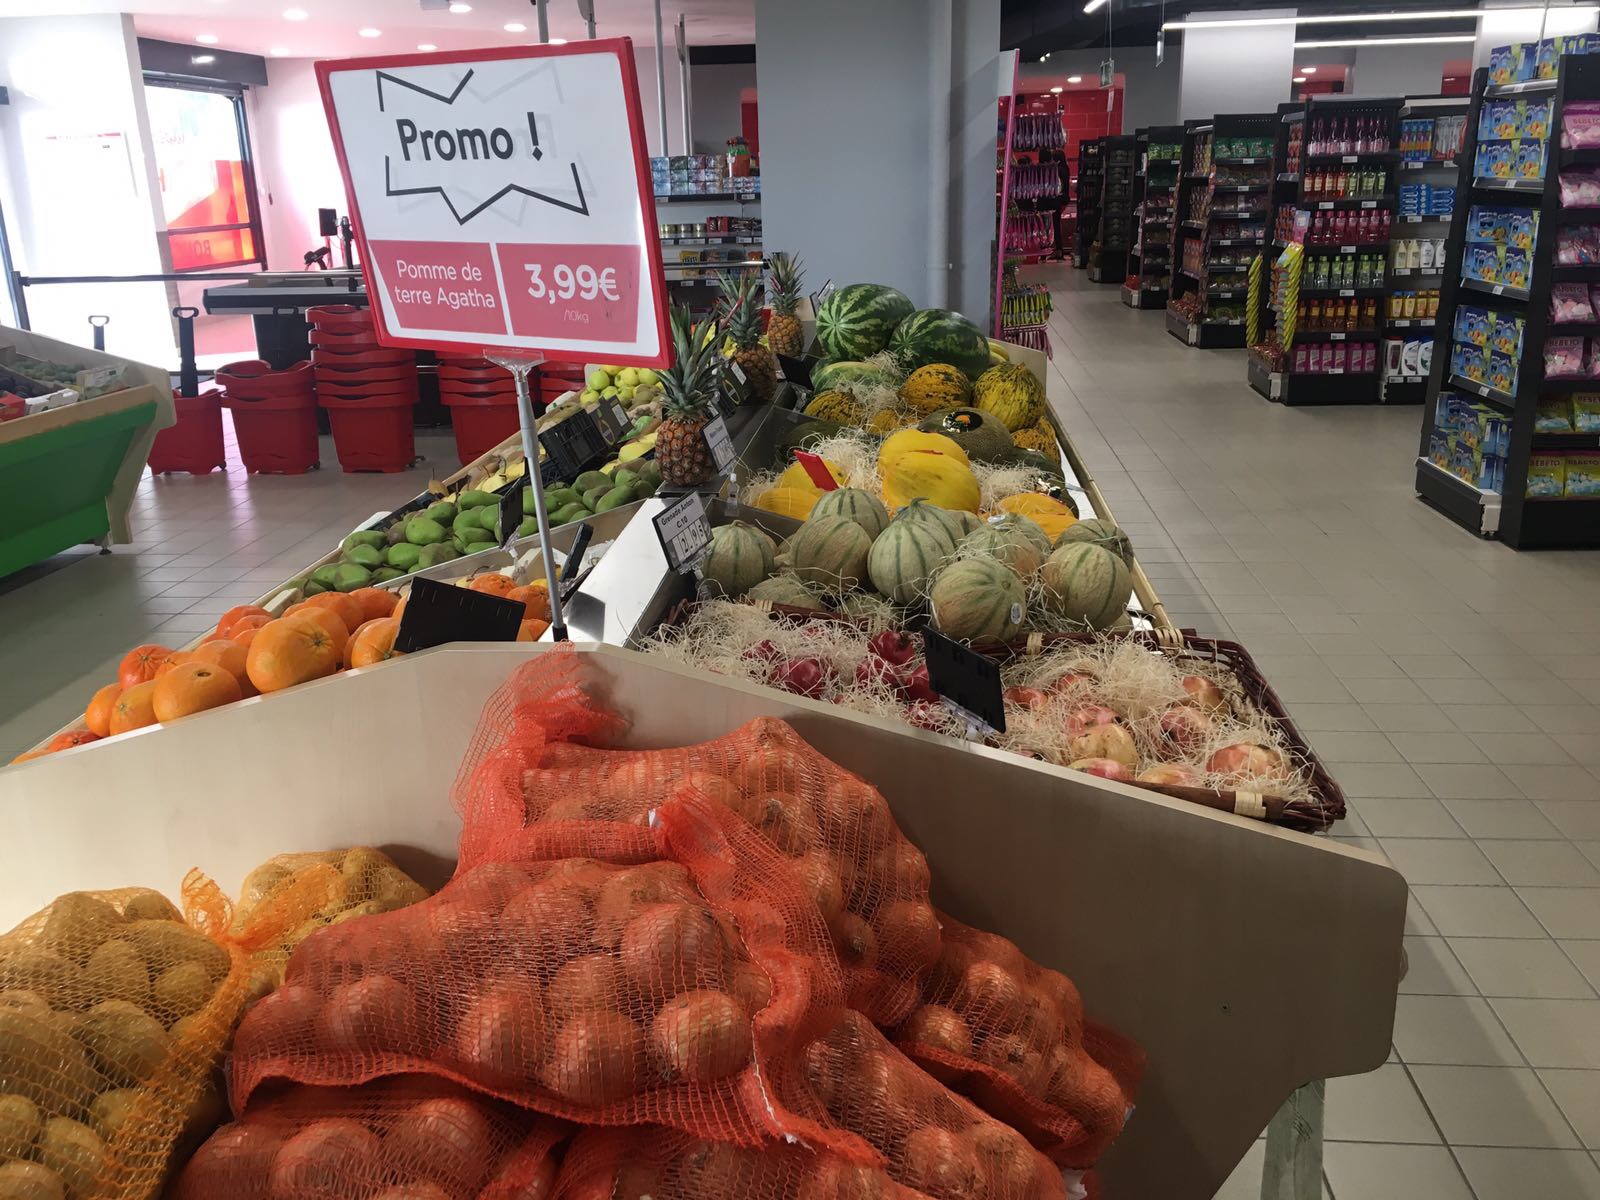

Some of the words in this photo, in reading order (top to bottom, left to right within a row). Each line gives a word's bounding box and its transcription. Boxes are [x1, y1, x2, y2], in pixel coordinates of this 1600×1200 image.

[396, 118, 514, 161] Promo
[527, 112, 543, 161] !
[396, 260, 457, 282] Pomme
[461, 263, 482, 282] de
[524, 264, 620, 304] 3,99€
[394, 286, 432, 305] terre
[437, 288, 496, 309] Agatha
[661, 507, 682, 526] Grenade
